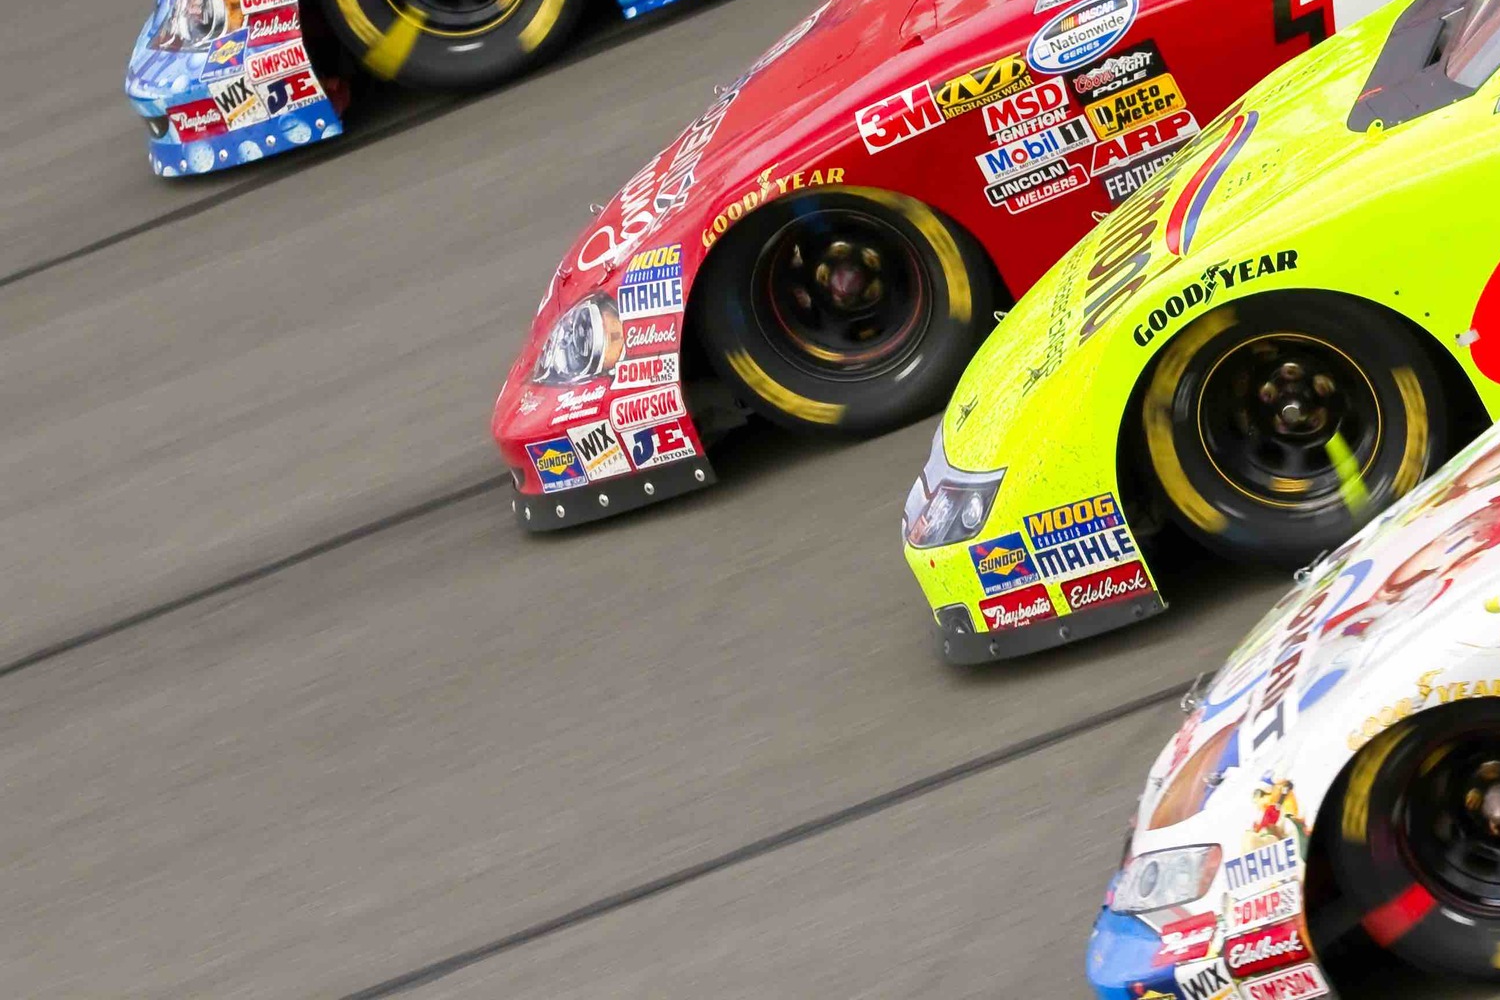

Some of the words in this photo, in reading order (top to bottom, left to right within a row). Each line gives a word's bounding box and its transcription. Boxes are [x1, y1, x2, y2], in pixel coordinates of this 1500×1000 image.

[250, 14, 301, 39] Edelbrock
[1078, 0, 1115, 25] NASCAR
[1049, 13, 1126, 54] Nationwide
[1063, 40, 1100, 61] SERIES
[251, 44, 304, 78] SIMPSON
[1073, 69, 1117, 93] Coors
[1111, 52, 1153, 77] LIGHT
[215, 76, 254, 112] WIX
[267, 71, 318, 115] JE
[944, 92, 1002, 120] MECHANIX
[1000, 74, 1035, 99] WEAR
[1093, 68, 1148, 98] POLE
[1115, 84, 1160, 112] Auto
[860, 85, 942, 148] 3M
[988, 84, 1064, 131] MSD
[1117, 91, 1176, 131] Meter
[994, 107, 1068, 146] IGNITION
[1094, 111, 1191, 171] ARP
[985, 130, 1060, 175] Mobil
[1019, 158, 1040, 171] MOTOR
[991, 161, 1066, 200] LINCOLN
[1015, 174, 1079, 208] WELDERS
[1105, 151, 1177, 200] FEATHE
[625, 268, 654, 284] CHASSIS
[657, 265, 681, 281] PARTS
[629, 244, 681, 273] MOOG
[619, 280, 682, 314] MAHLE
[626, 322, 677, 347] Edelbrock
[618, 359, 663, 384] COMP
[650, 372, 673, 383] CAMS
[616, 390, 679, 426] SIMPSON
[575, 423, 616, 461] WIX
[632, 421, 687, 466] JE
[652, 448, 695, 465] PISTONS
[538, 452, 575, 472] SUNOCO
[588, 452, 625, 479] FILTERS
[1029, 496, 1115, 537] MOOG
[1035, 528, 1136, 578] MAHLE
[1037, 527, 1081, 549] CHASSIS
[979, 549, 1025, 573] SUNOCO
[1070, 570, 1148, 608] Edelbrock
[993, 597, 1051, 630] Raybestos
[1225, 838, 1297, 891] MAHLE
[1234, 891, 1280, 927] COMP
[1183, 962, 1229, 1000] WIX
